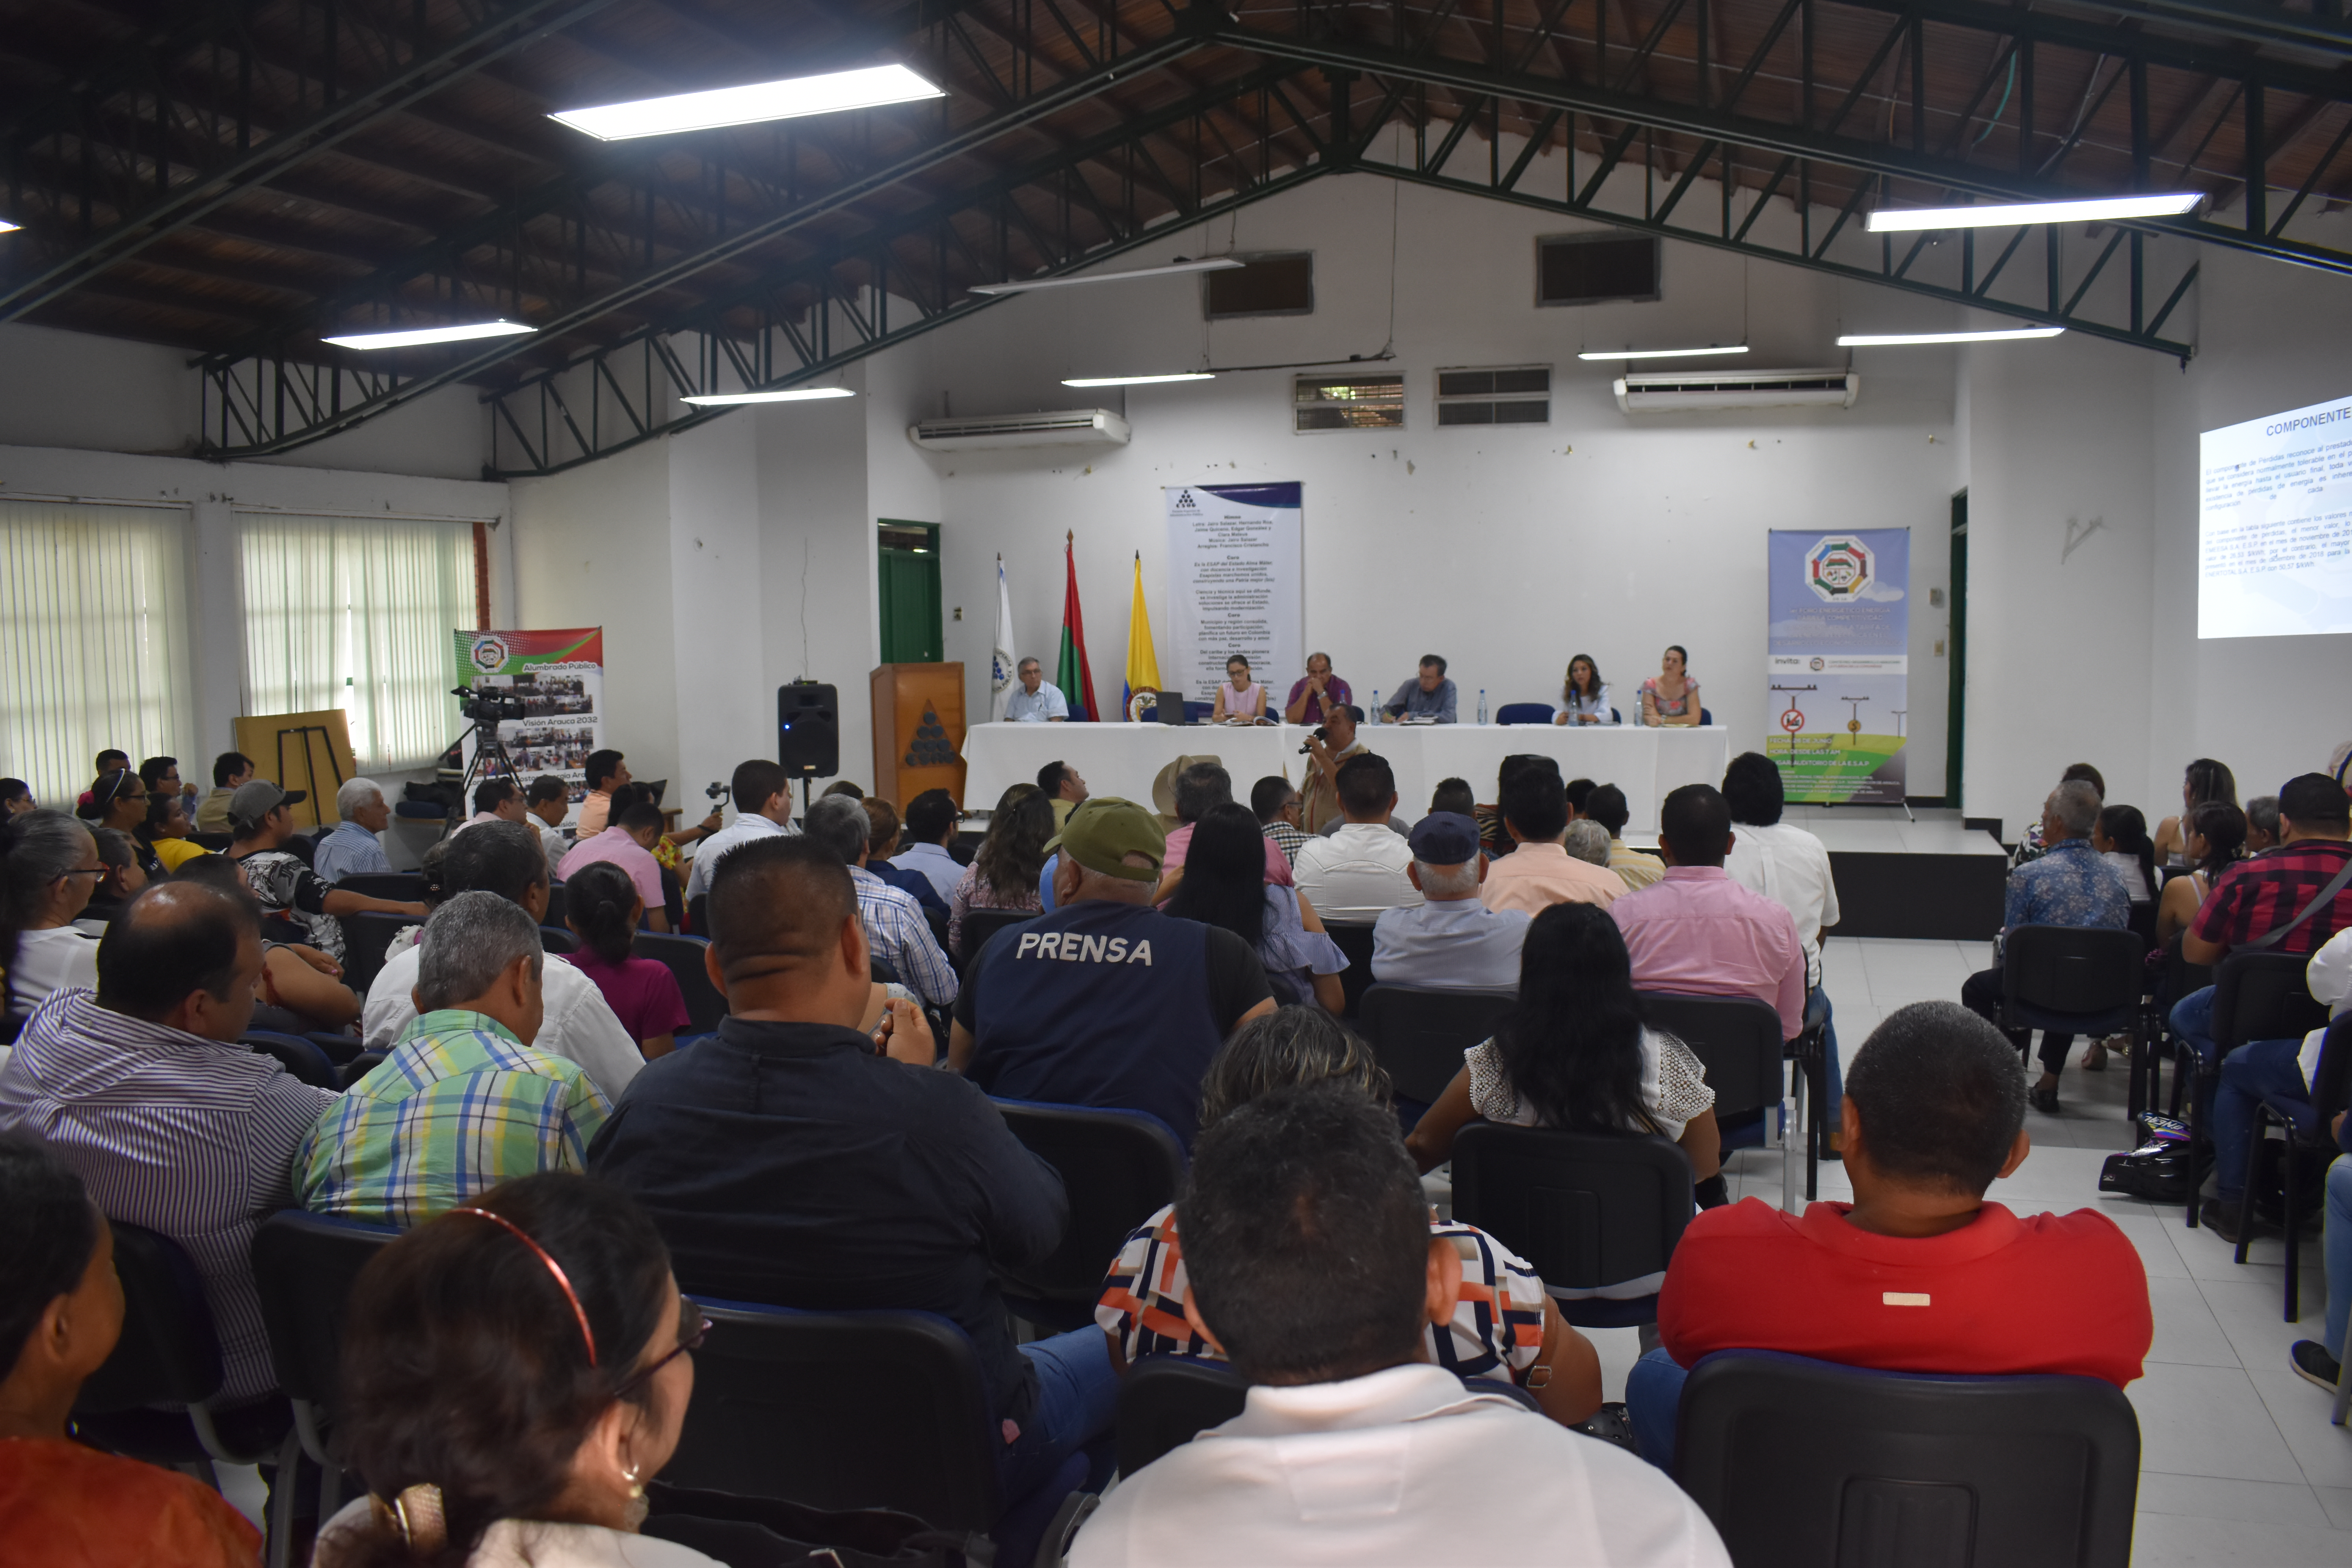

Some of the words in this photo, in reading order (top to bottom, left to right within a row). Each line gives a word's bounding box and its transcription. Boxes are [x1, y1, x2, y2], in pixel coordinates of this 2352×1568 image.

[2267, 407, 2351, 436] COMPONENTE
[2214, 462, 2247, 473] componnte
[524, 663, 567, 671] Alumbrado
[523, 718, 546, 726] Visión
[1016, 932, 1152, 966] PRENSA
